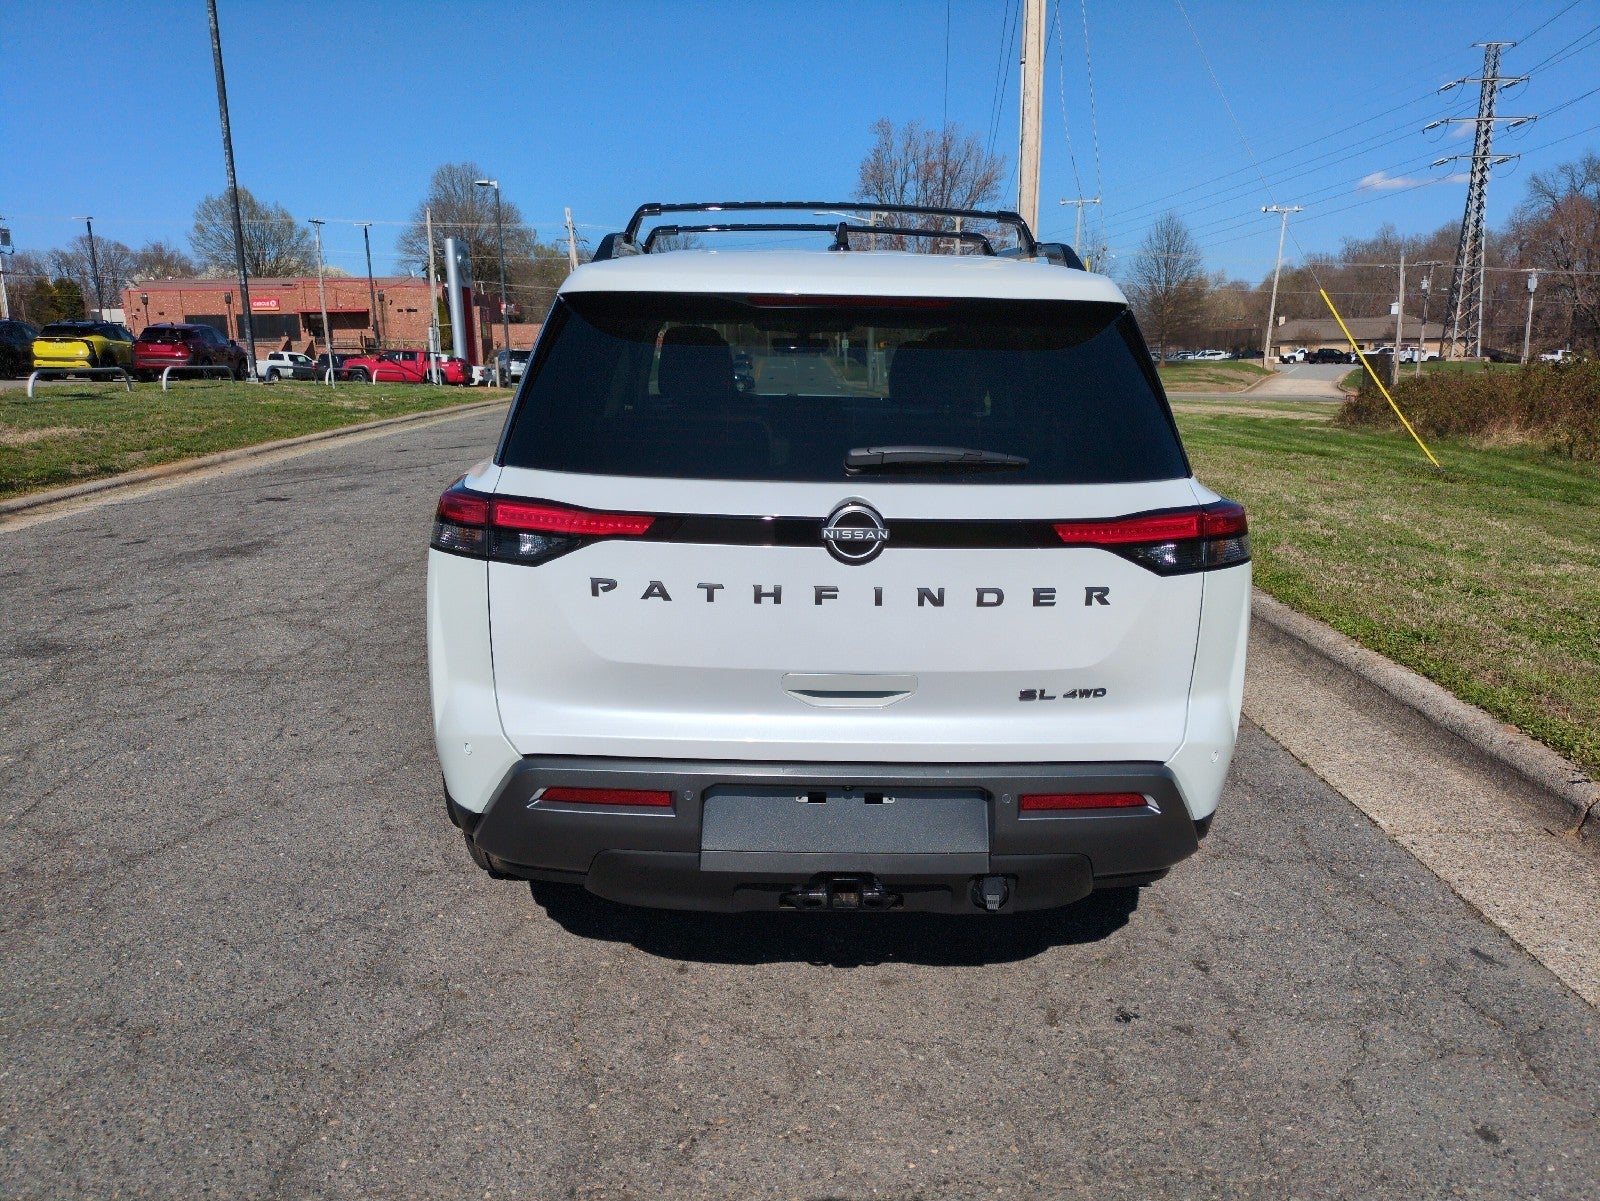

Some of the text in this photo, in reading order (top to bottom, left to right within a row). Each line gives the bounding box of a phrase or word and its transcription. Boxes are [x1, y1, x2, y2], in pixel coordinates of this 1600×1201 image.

[823, 530, 888, 540] NISSAN
[590, 577, 1111, 607] PATHFINDER
[1018, 688, 1107, 702] SL 4WD
